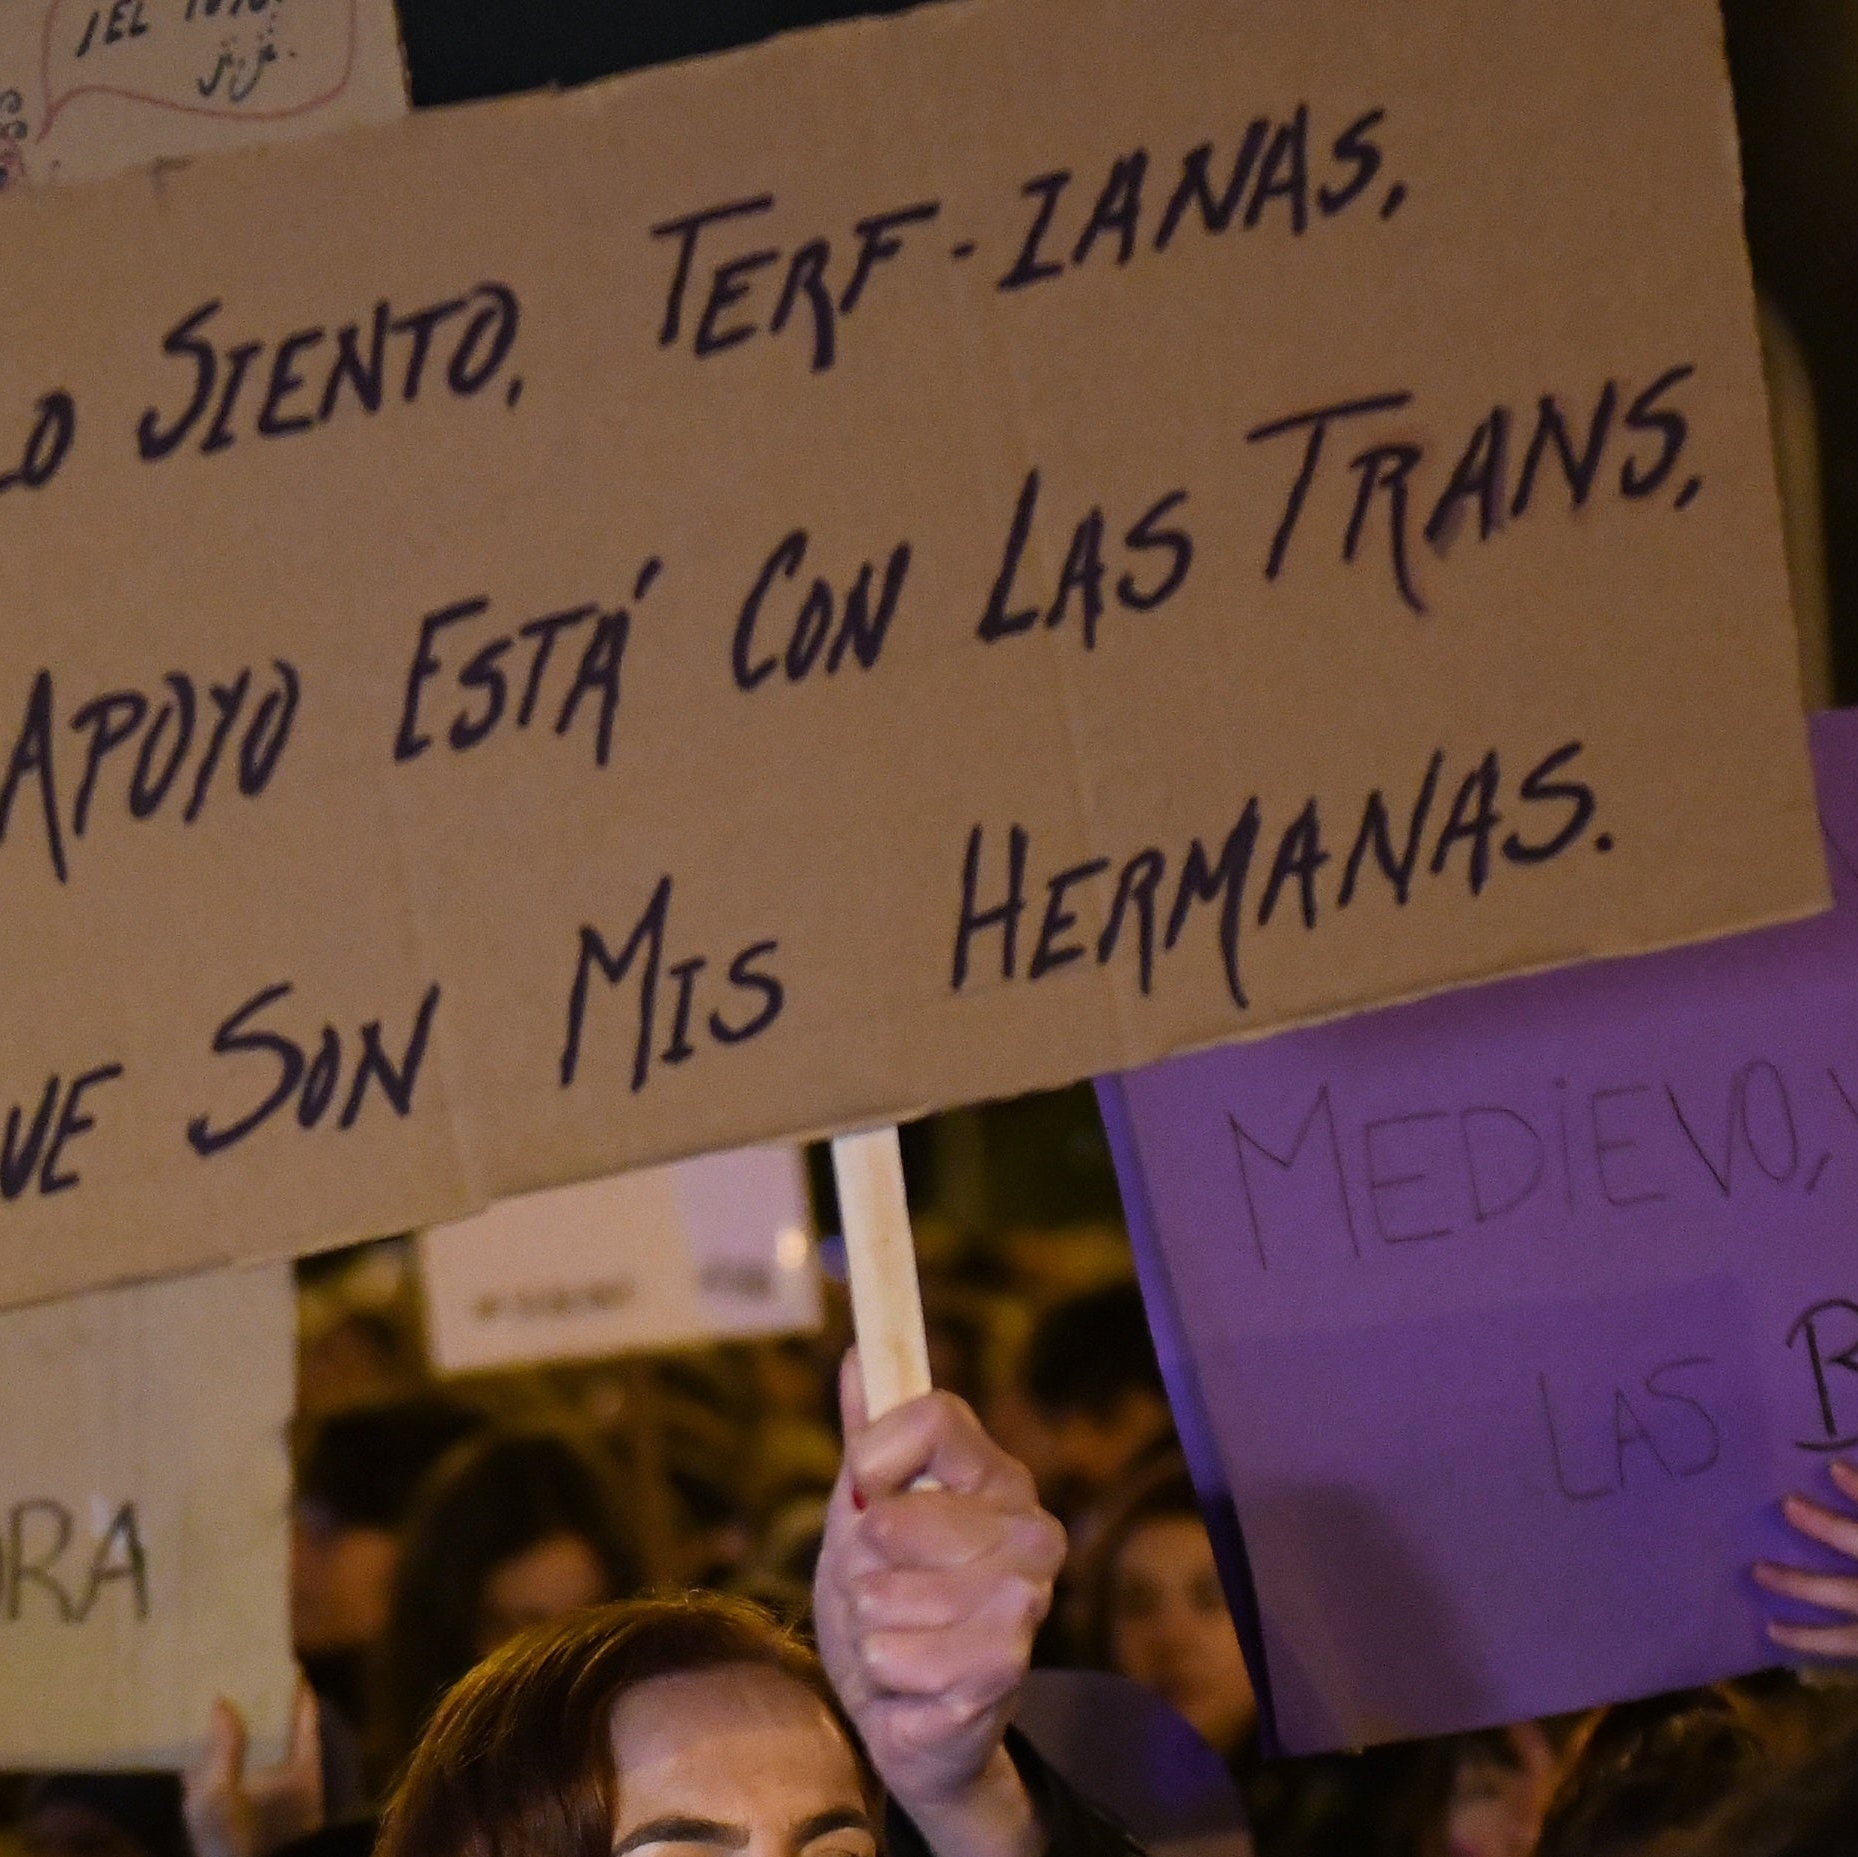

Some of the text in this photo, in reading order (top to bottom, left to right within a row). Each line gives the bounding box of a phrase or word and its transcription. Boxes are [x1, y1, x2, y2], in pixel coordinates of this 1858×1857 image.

[393, 556, 662, 767] ESTÁ
[732, 530, 911, 692] CON
[978, 469, 1192, 649] LAS
[187, 982, 440, 1157] SON
[559, 875, 785, 1092] MIS
[952, 742, 1614, 1010] HERMANAS.
[1541, 1357, 1723, 1503] LAS
